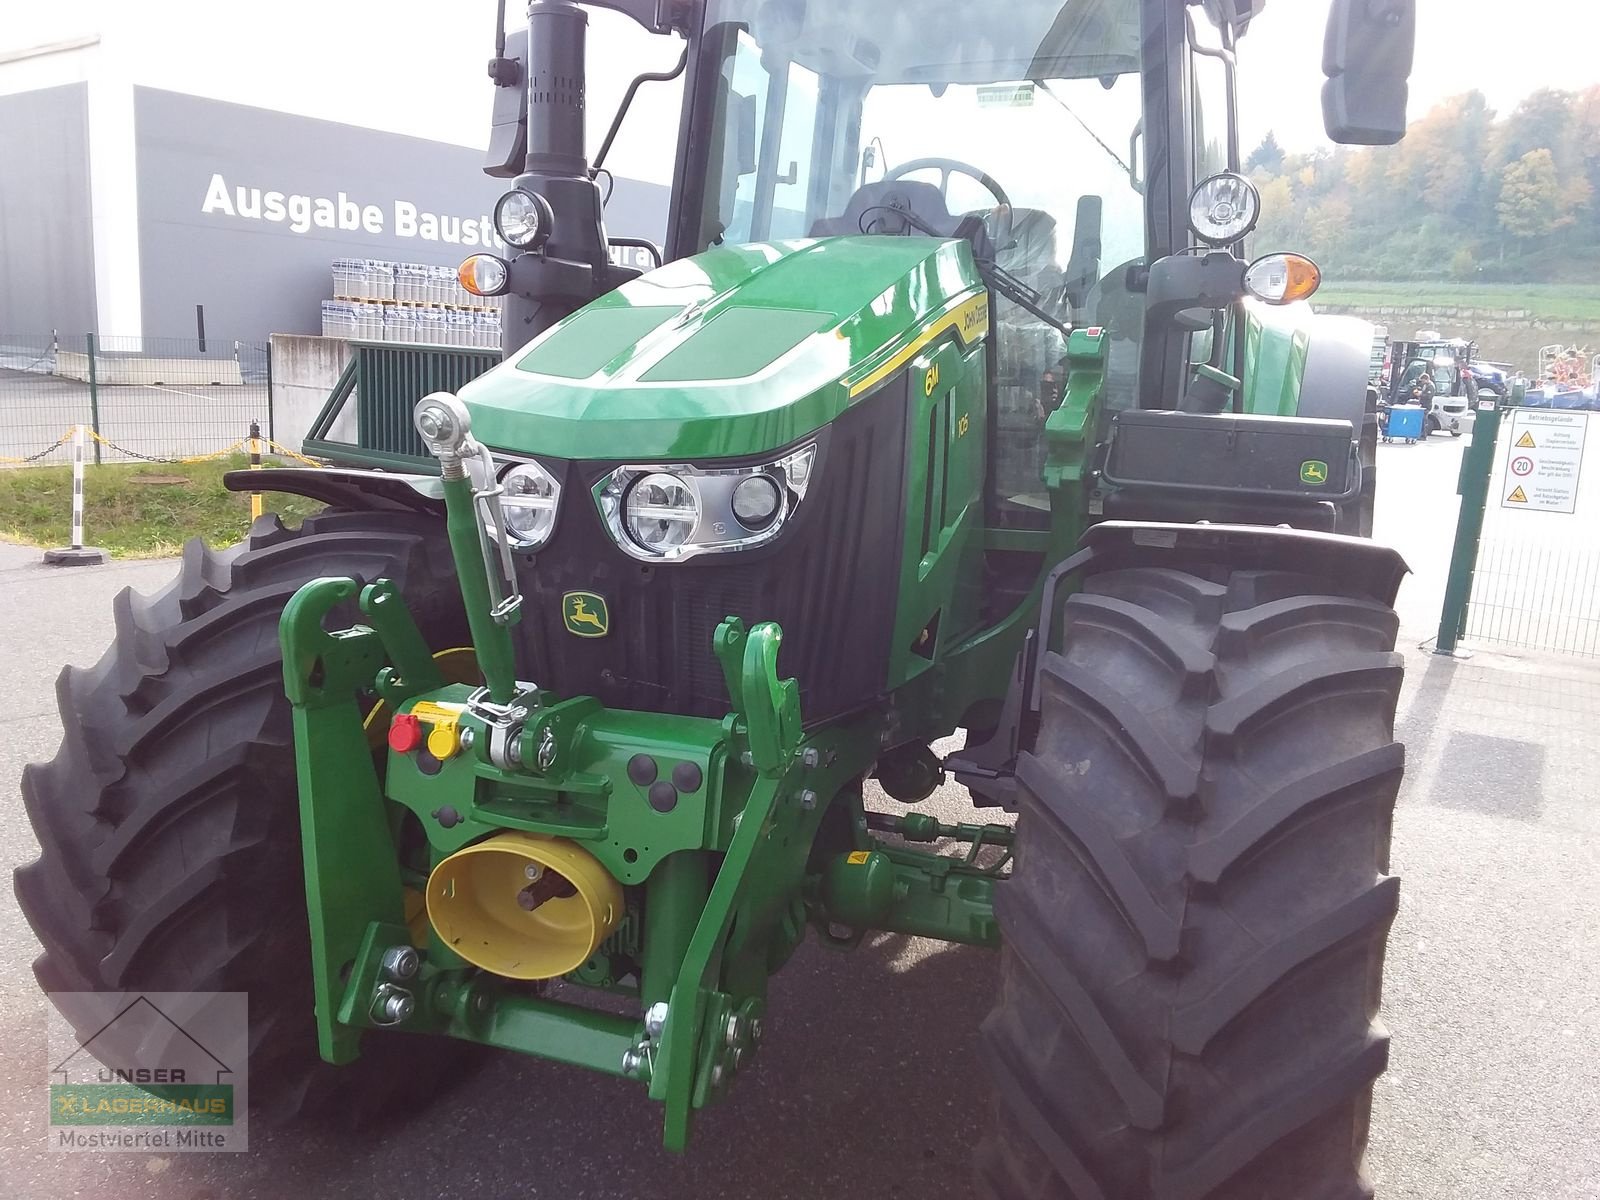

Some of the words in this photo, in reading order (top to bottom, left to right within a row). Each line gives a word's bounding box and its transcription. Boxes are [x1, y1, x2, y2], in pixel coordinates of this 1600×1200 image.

[201, 173, 384, 233] Ausgabe
[925, 363, 938, 396] 6M
[958, 412, 969, 438] 105
[1516, 461, 1528, 471] 20
